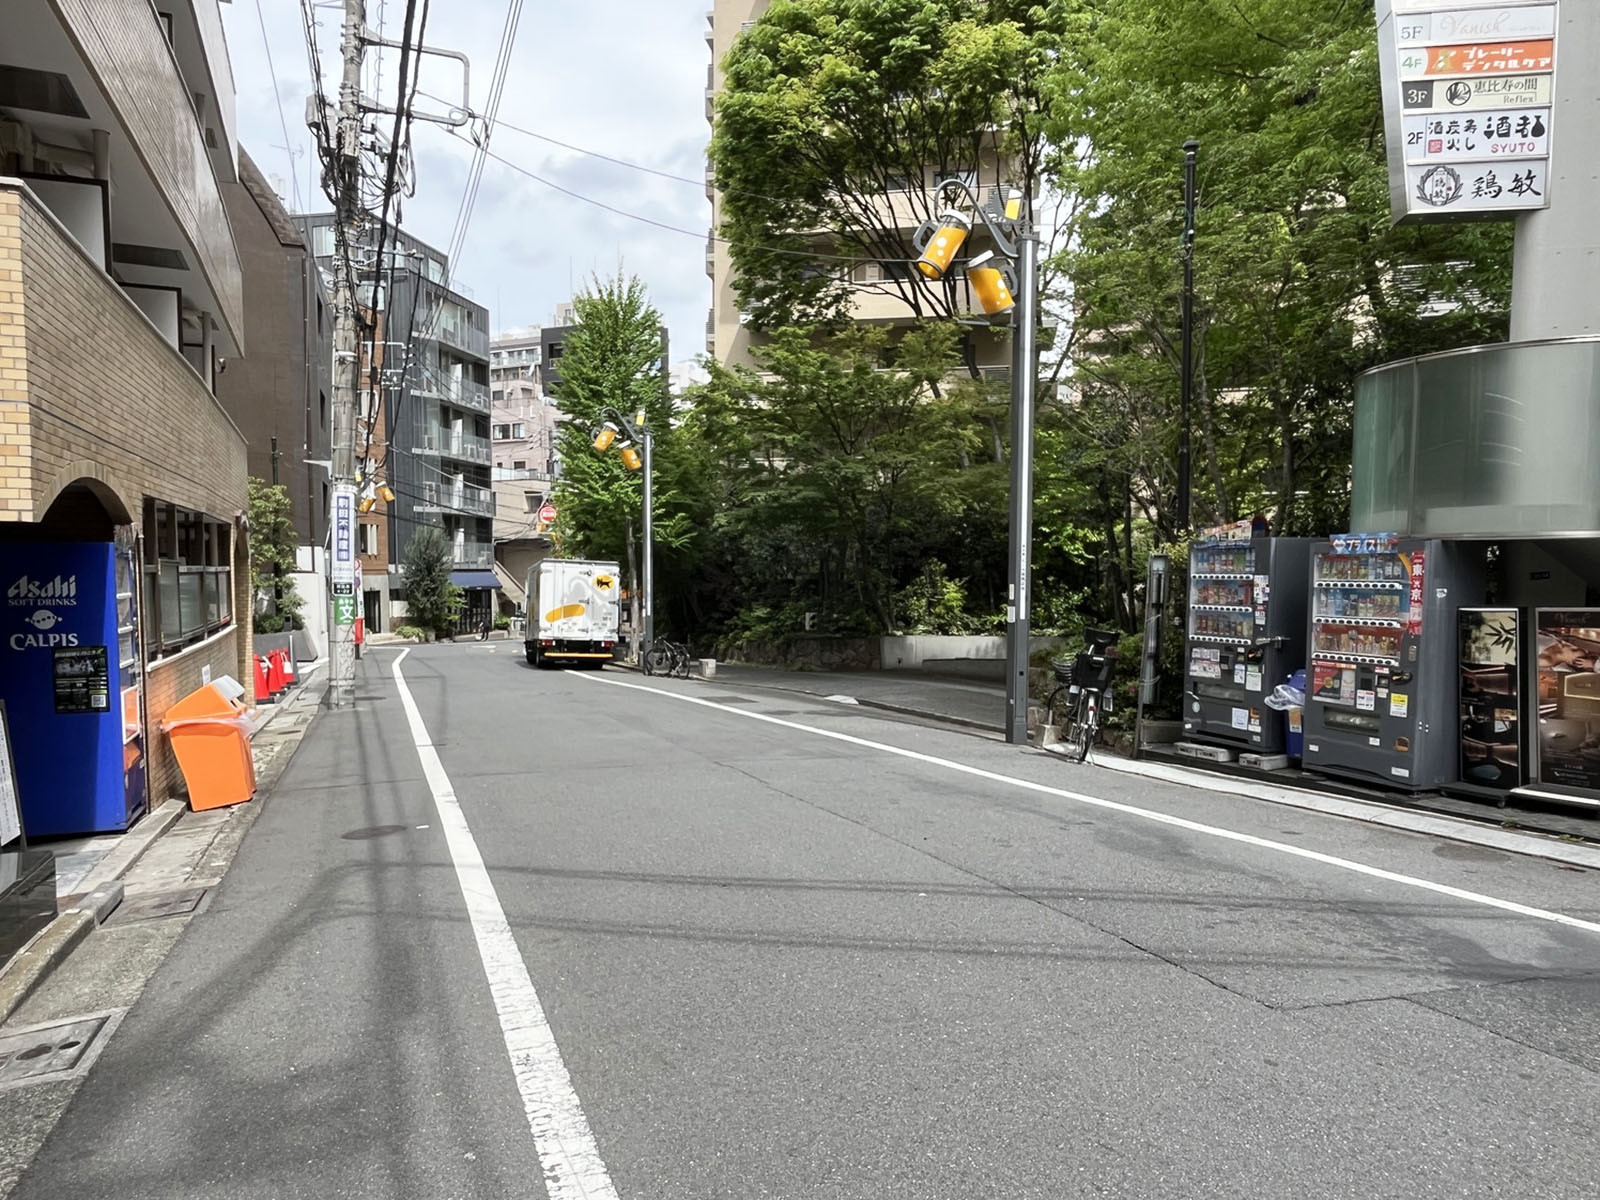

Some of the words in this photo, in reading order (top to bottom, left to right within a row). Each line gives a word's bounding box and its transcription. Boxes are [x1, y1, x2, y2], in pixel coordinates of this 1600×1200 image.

[1440, 11, 1511, 36] Vanish
[1401, 25, 1423, 40] 5F
[1463, 47, 1525, 59] プレーリー
[1402, 56, 1422, 69] 4F
[1473, 77, 1538, 93] 恵比寿の間
[1407, 88, 1428, 103] 3F
[1503, 95, 1534, 104] Reflex
[1407, 131, 1424, 145] 2F
[1491, 142, 1535, 154] SYUTO
[8, 575, 77, 598] Asahi
[8, 598, 36, 606] SOFT
[38, 598, 77, 606] DRINKS
[9, 633, 79, 651] CALPIS
